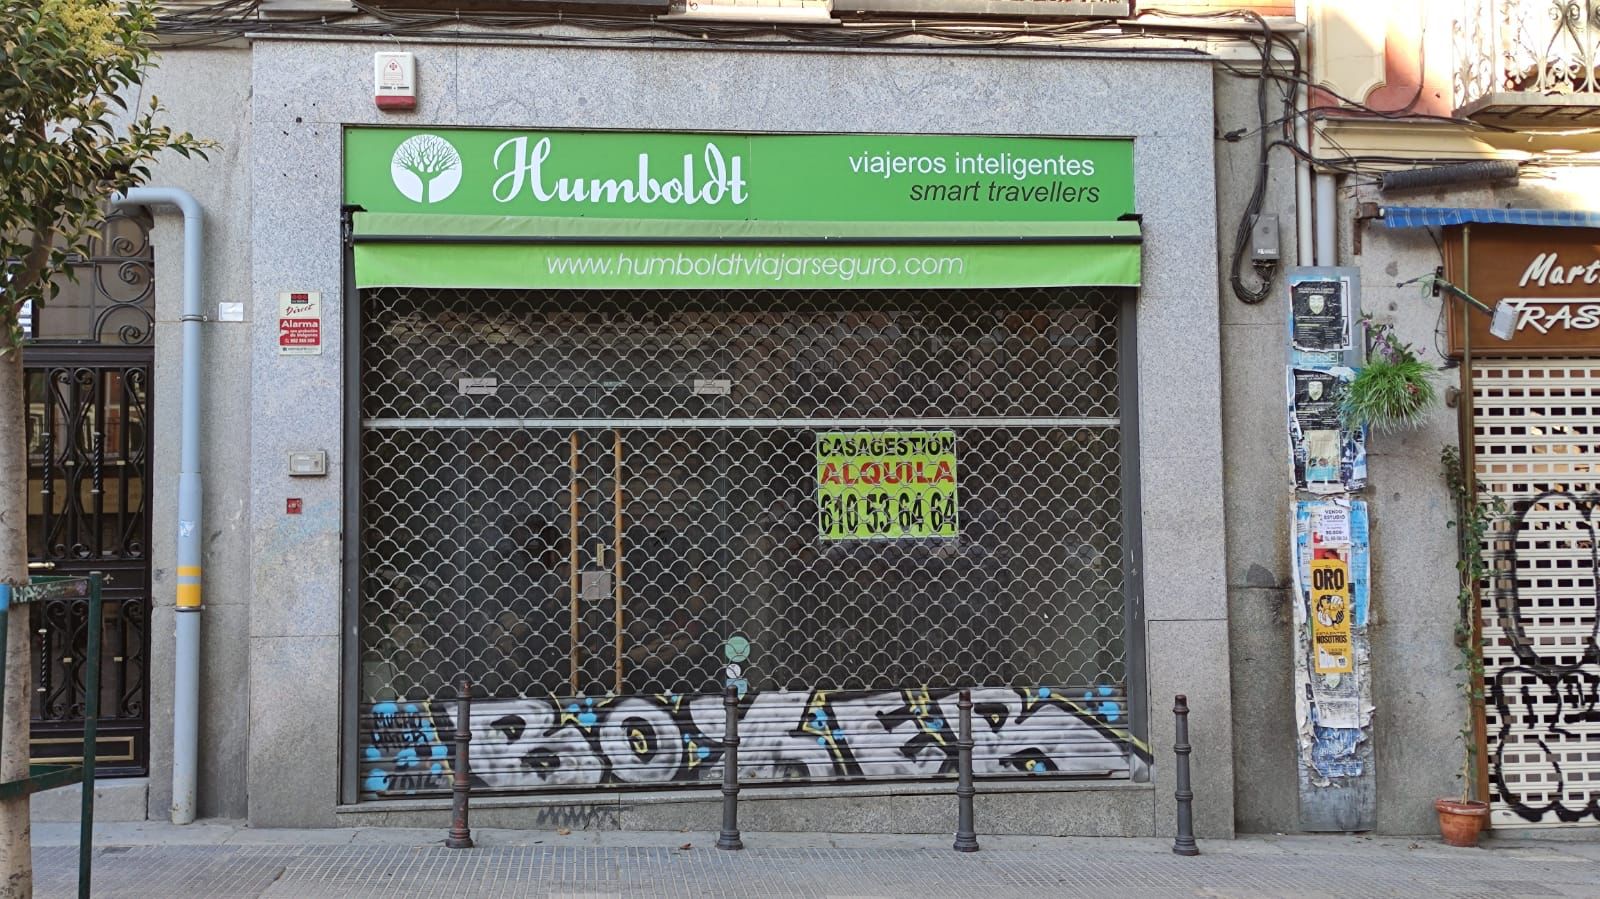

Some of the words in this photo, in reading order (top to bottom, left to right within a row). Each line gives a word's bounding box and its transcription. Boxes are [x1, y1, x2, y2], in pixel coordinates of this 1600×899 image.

[492, 136, 748, 205] Humboldt
[849, 151, 947, 179] viajeros
[955, 153, 1095, 180] inteligentes
[909, 181, 981, 202] smart
[988, 181, 1100, 203] travellers
[547, 252, 965, 281] www.humboldtviajarseguro.com
[1518, 252, 1600, 287] Mart
[281, 319, 319, 328] Alarma
[819, 434, 956, 457] CASAGESTIÓN
[820, 460, 955, 486] ALQUILA
[820, 493, 860, 535] 610
[865, 493, 892, 534] 53
[898, 492, 925, 534] 64
[930, 491, 957, 533] 64
[1313, 568, 1345, 591] ORO
[1316, 635, 1348, 644] NOSOTROS
